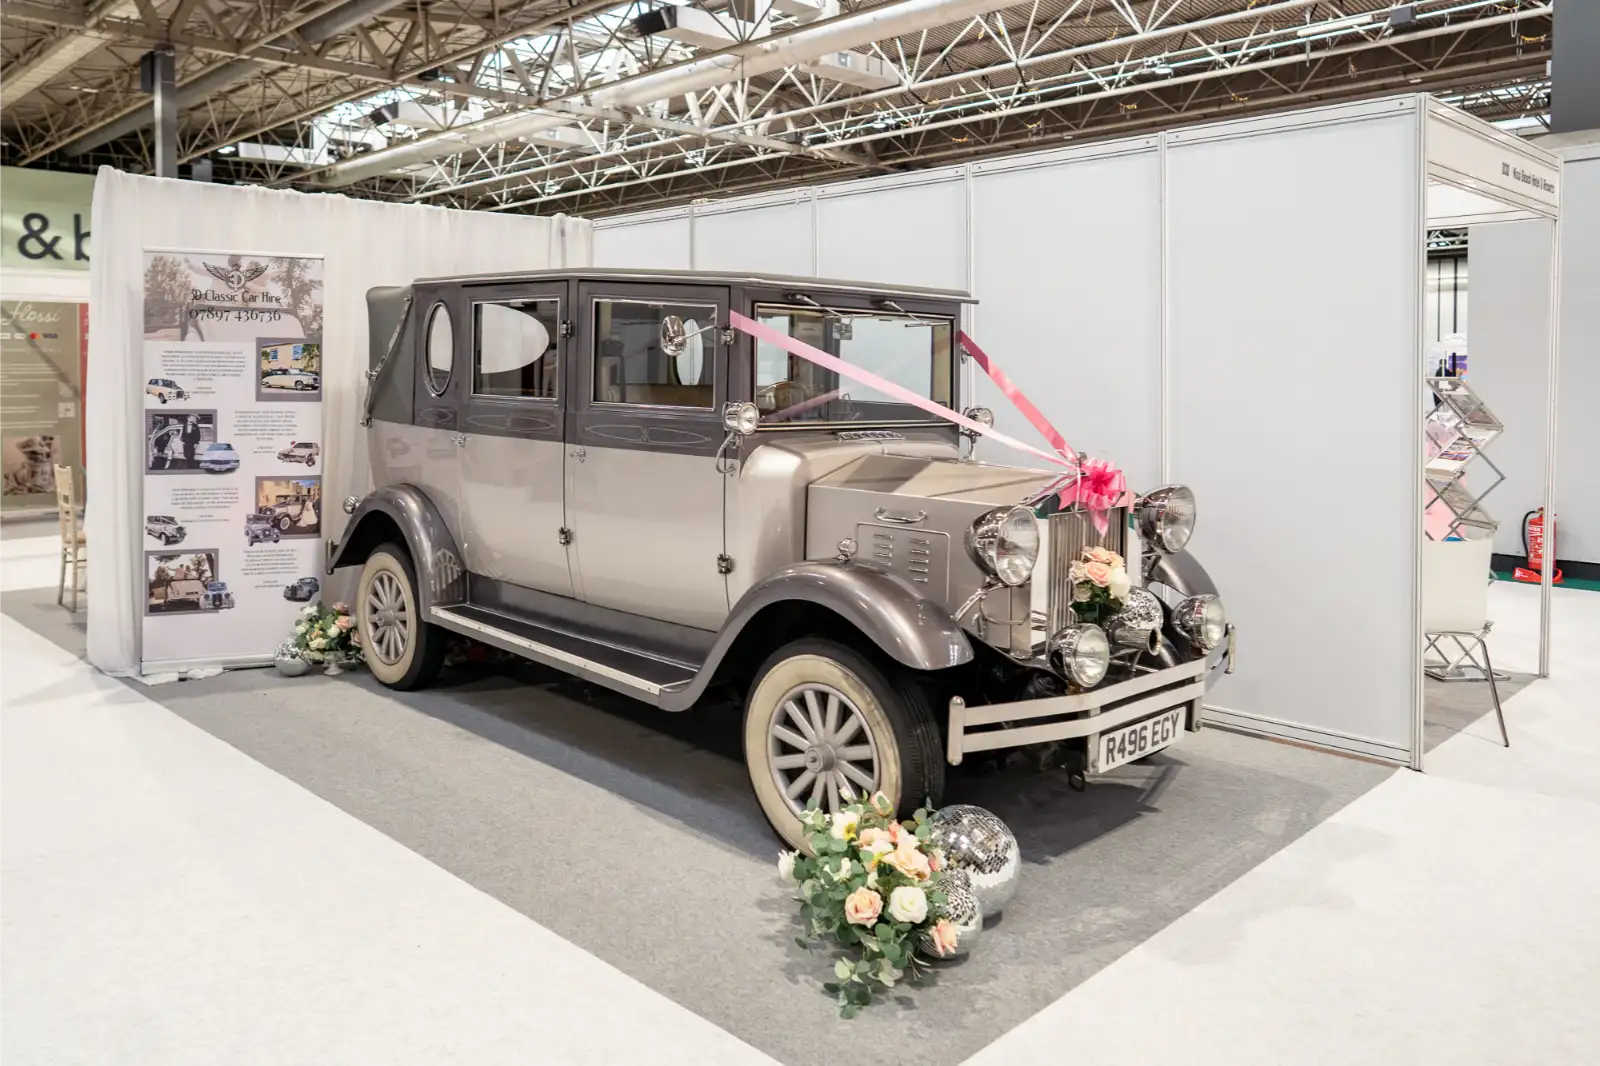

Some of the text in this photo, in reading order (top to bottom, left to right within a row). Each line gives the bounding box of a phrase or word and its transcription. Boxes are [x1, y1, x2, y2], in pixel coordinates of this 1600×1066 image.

[18, 212, 63, 260] &
[205, 290, 239, 303] Classic
[242, 291, 259, 303] Car
[262, 292, 281, 304] Hire
[189, 307, 281, 323] 07897 436736
[1106, 711, 1180, 765] R496 EGY
